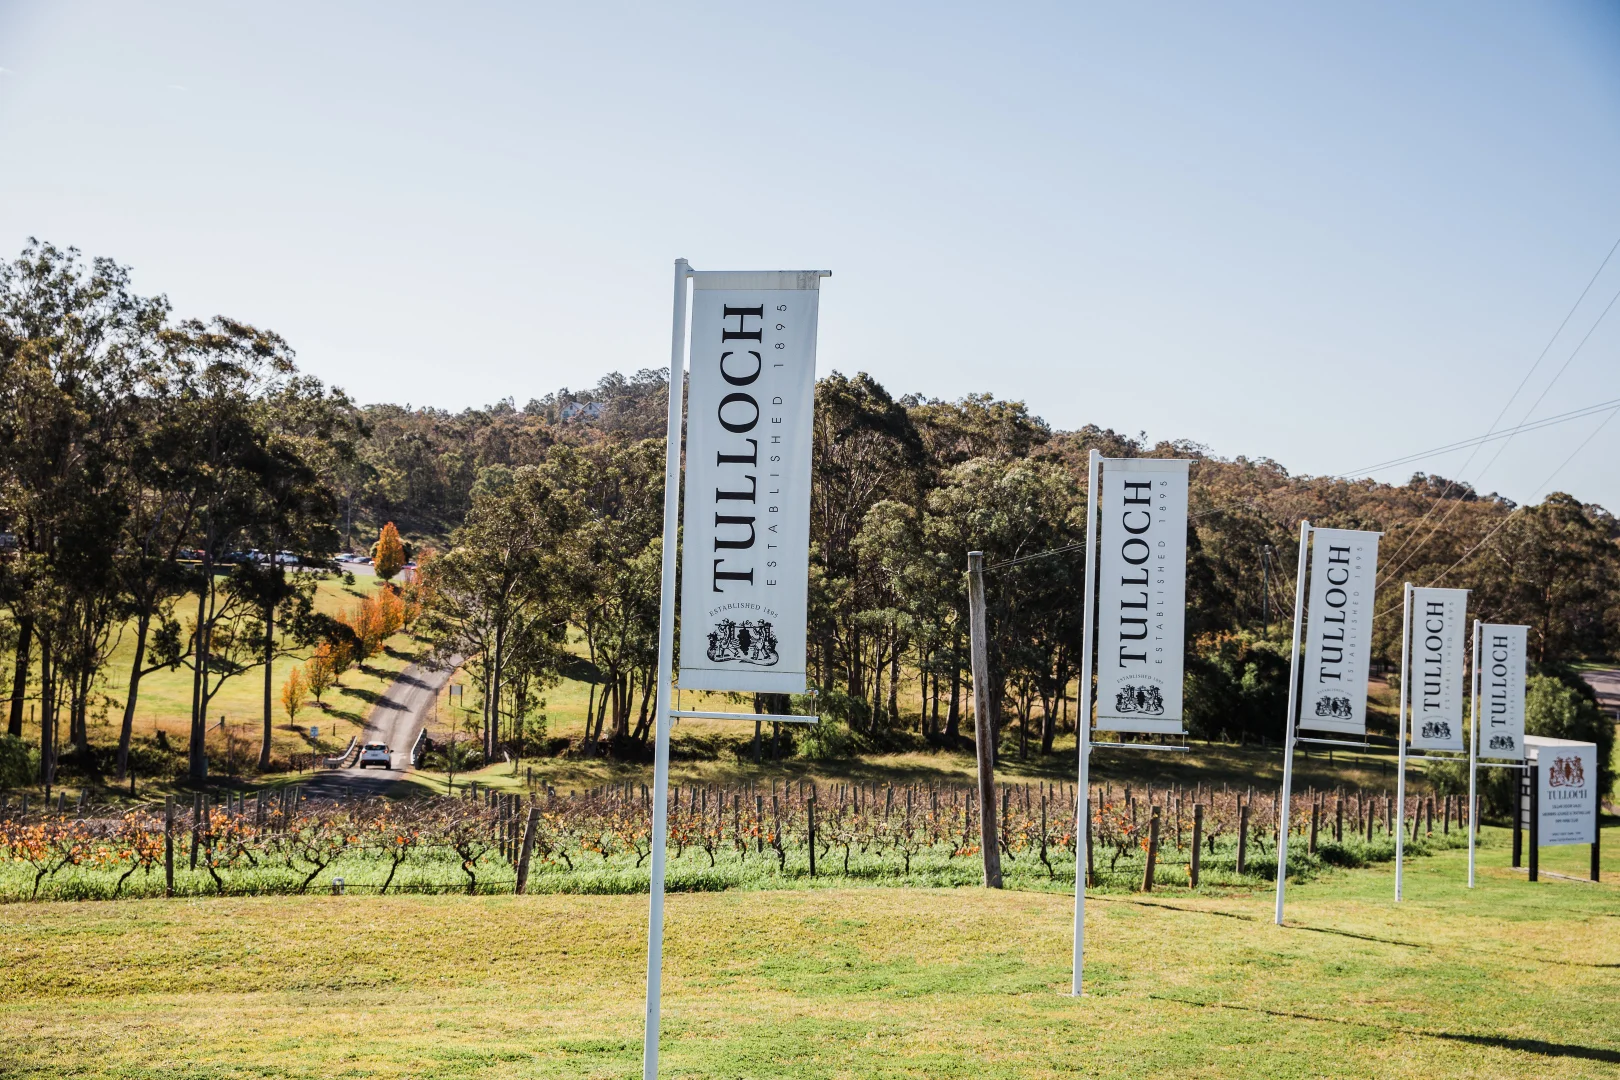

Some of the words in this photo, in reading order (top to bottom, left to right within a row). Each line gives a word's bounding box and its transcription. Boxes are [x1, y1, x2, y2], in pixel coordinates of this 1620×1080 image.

[773, 304, 787, 368] 1895
[713, 303, 764, 593] TULLOCH
[766, 396, 783, 586] ESTABLISHED
[1158, 480, 1168, 523] 1895
[708, 602, 761, 617] ESTABLISHED
[763, 606, 779, 619] 1895
[1119, 479, 1152, 668] TULLOCH
[1155, 540, 1166, 664] ESTABLISHED
[1319, 544, 1351, 684] TULLOCH
[1347, 591, 1360, 682] ESTABLISHED
[1423, 601, 1445, 712] TULLOCH
[1491, 635, 1509, 728] TULLOCH
[1547, 789, 1588, 800] TULLOCH
